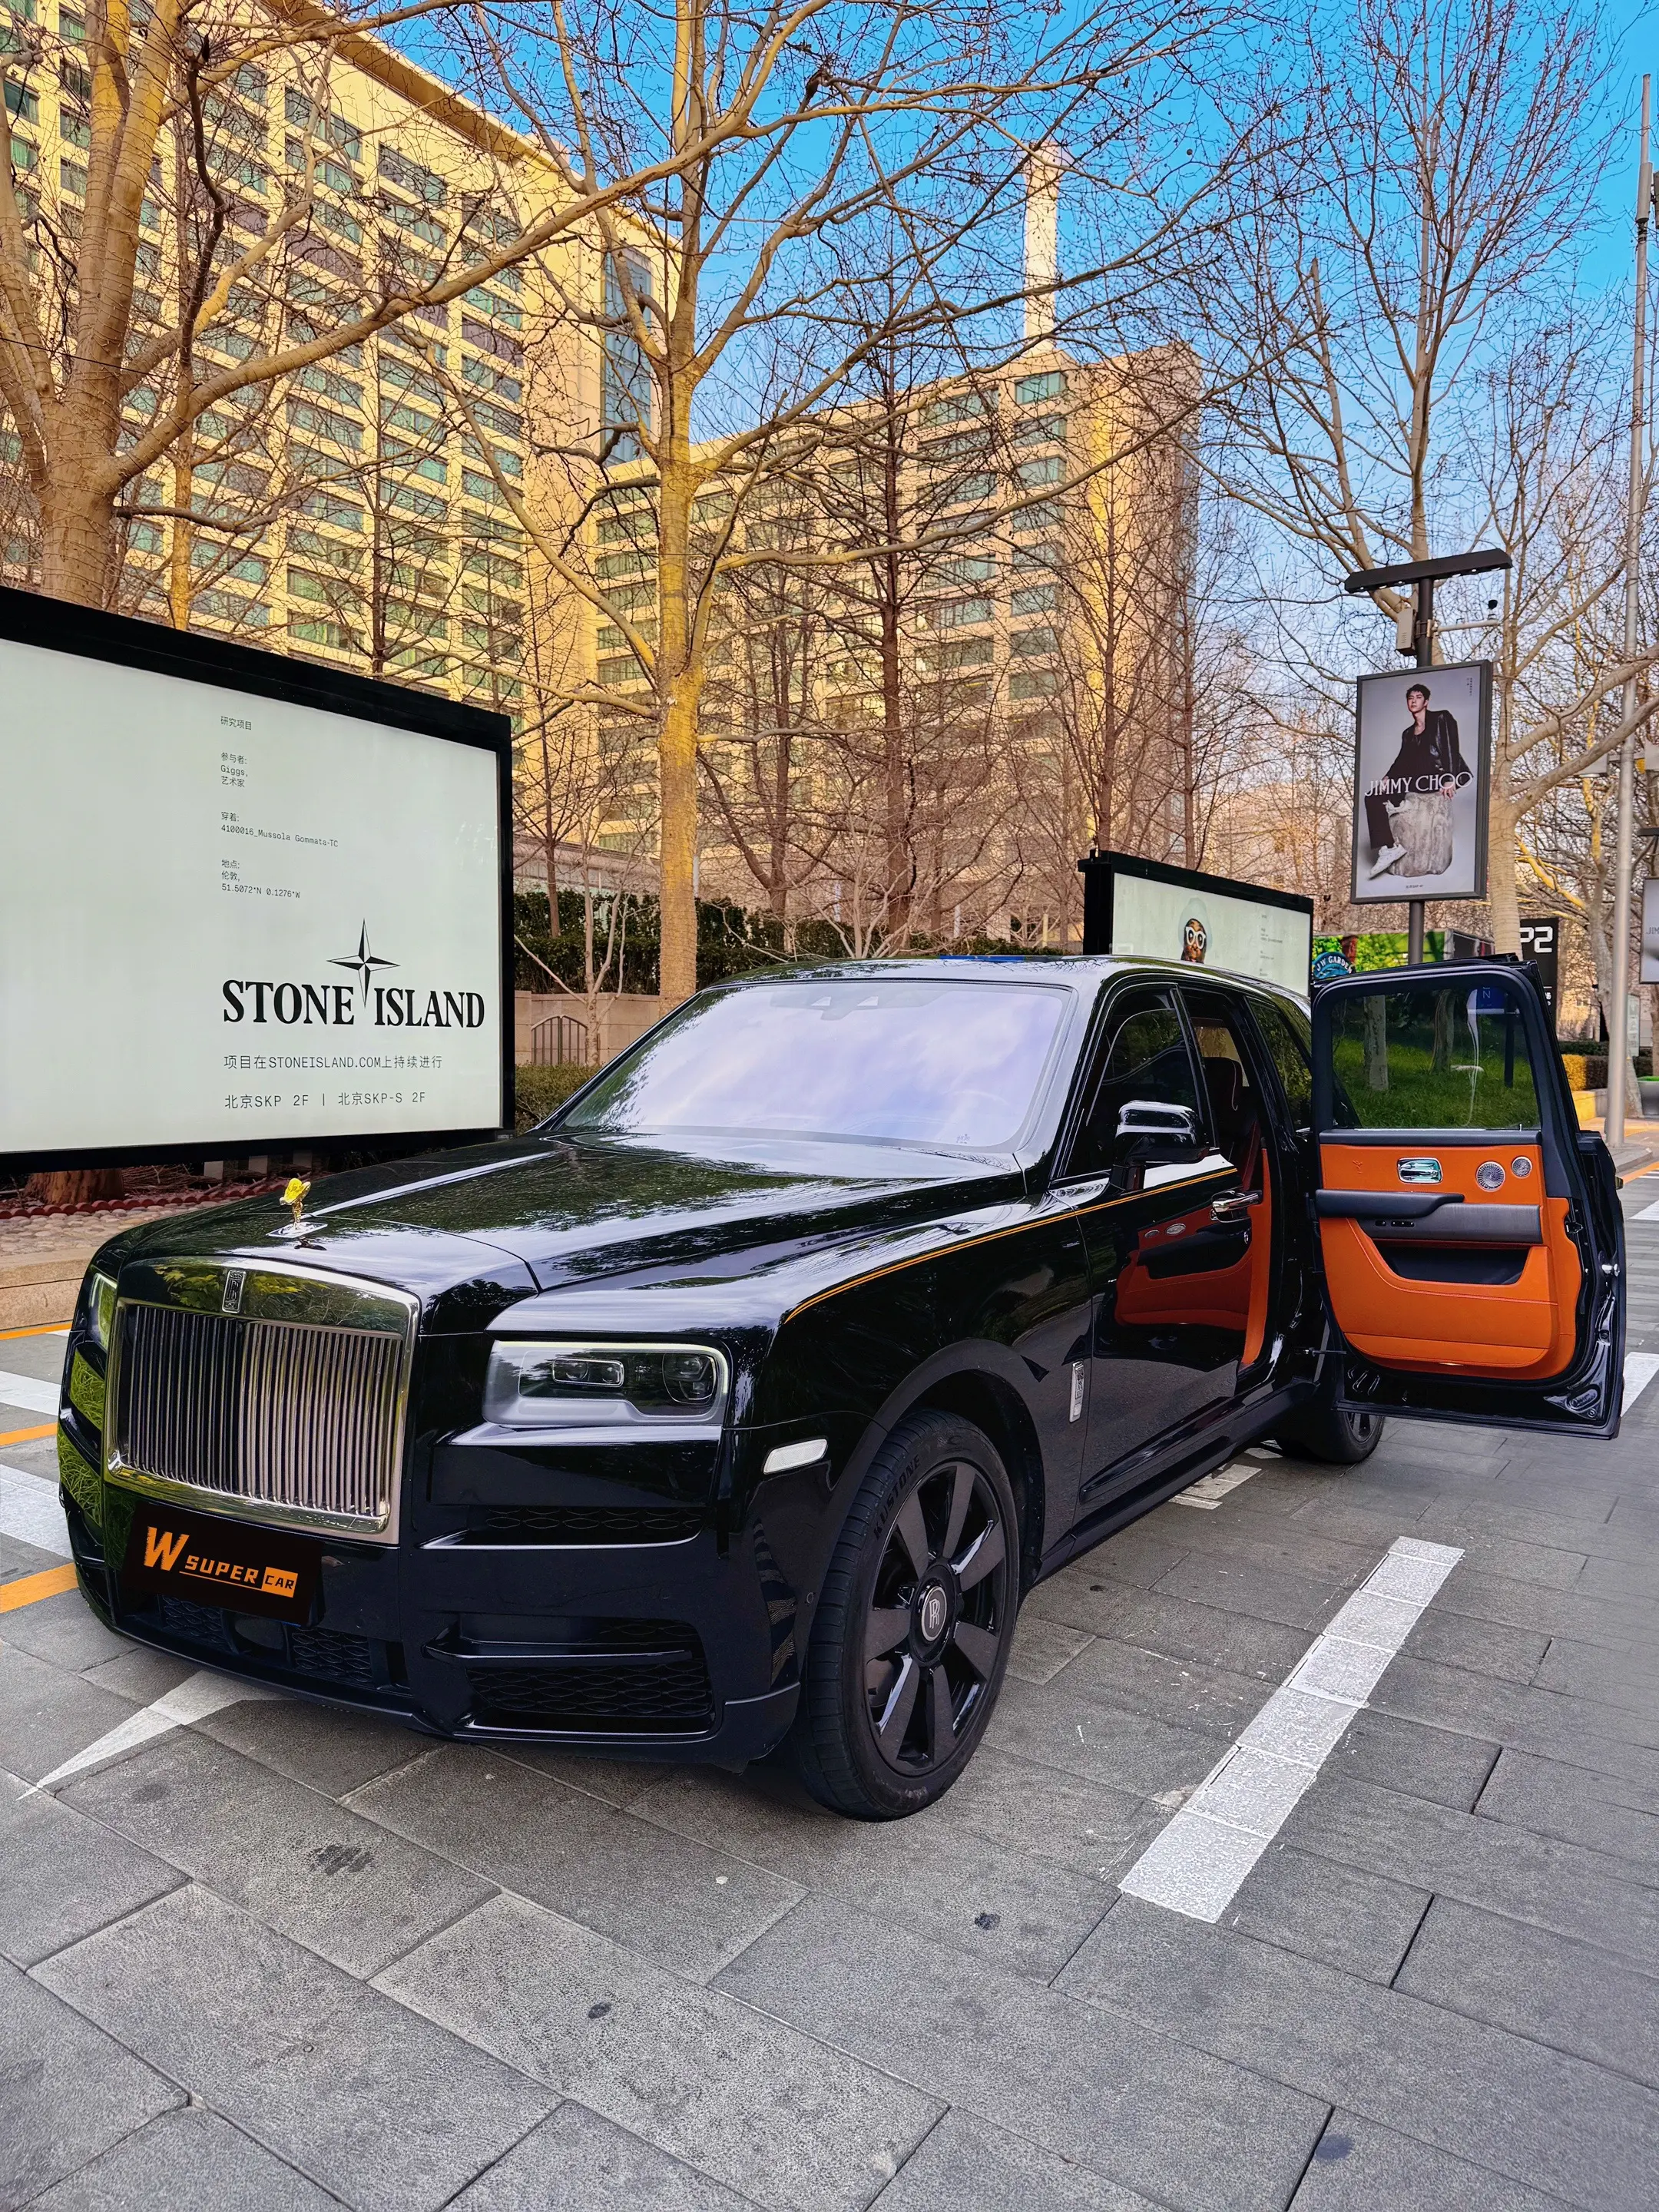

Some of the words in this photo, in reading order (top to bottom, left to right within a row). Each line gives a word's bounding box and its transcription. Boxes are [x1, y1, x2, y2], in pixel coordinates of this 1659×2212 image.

[220, 716, 252, 730] 研究项目
[220, 765, 248, 777] Giggs,
[221, 776, 245, 788] 艺术家
[1364, 777, 1412, 796] JIMMY
[1416, 771, 1472, 791] CHOO
[220, 824, 291, 841] 4100016_Mussola
[295, 834, 339, 848] Gommata-TC
[222, 979, 355, 1025] STONE
[373, 987, 485, 1028] ISLAND
[224, 1055, 442, 1070] 项目在STONEISLAND.COM上持续进行
[224, 1094, 282, 1109] 北京SKP
[293, 1094, 309, 1107] 2F
[338, 1091, 402, 1106] 北京SKP-S
[412, 1091, 426, 1104] 2F
[144, 1526, 190, 1571] W
[184, 1555, 259, 1584] SUPER
[264, 1575, 295, 1590] CAR
